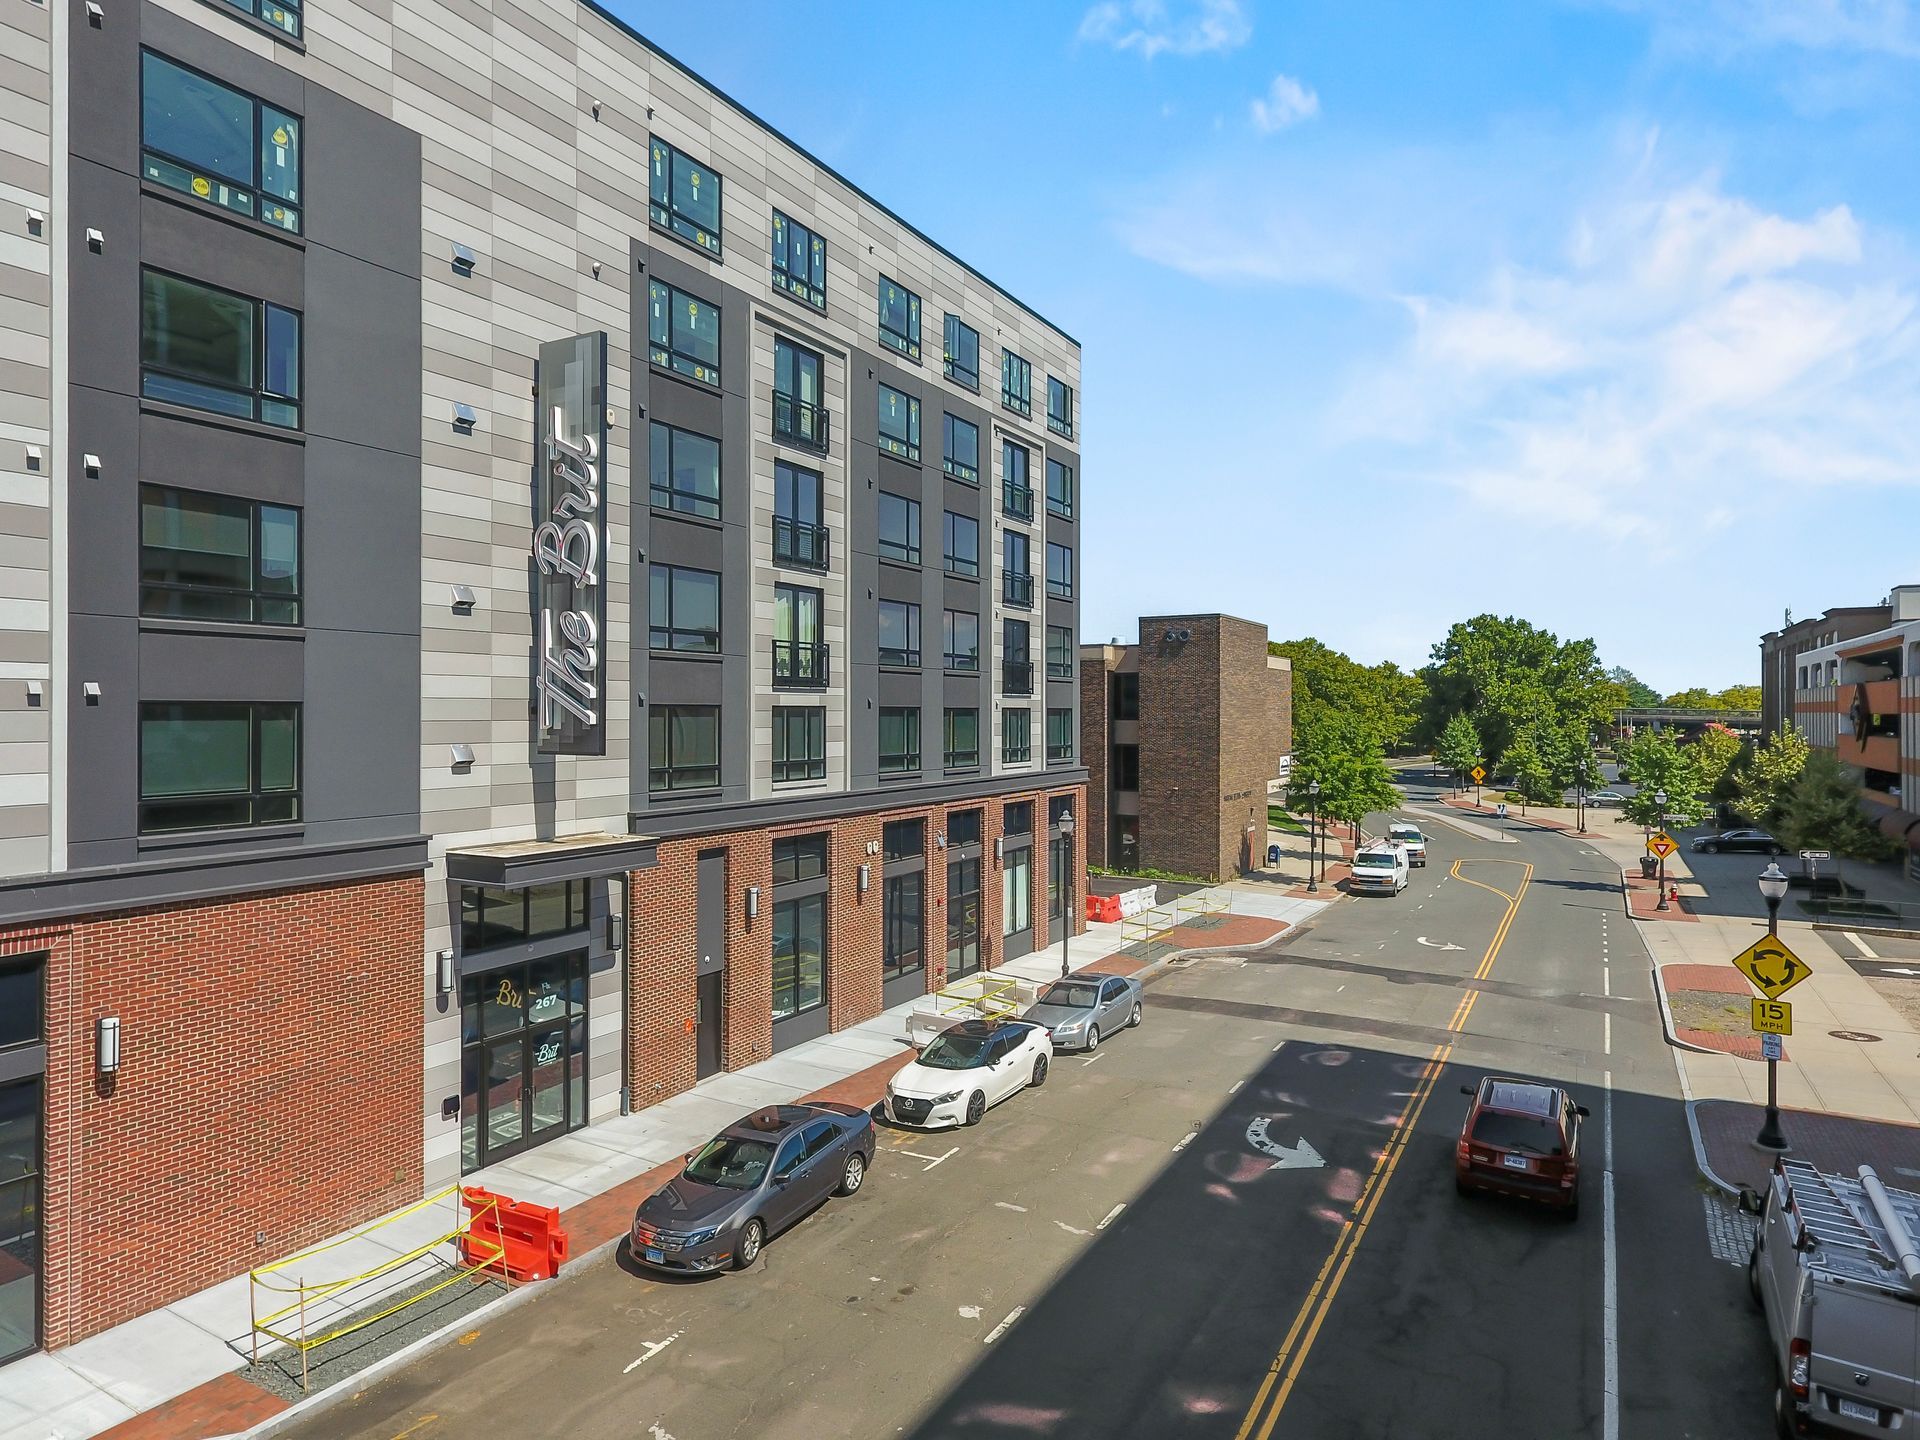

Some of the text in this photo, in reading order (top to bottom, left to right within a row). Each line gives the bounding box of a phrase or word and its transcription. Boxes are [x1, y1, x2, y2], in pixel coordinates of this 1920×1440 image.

[535, 406, 598, 730] The Brit
[535, 994, 557, 1010] 267
[1759, 1003, 1784, 1020] 15
[1760, 1021, 1783, 1030] MPH
[537, 1043, 560, 1062] Brit
